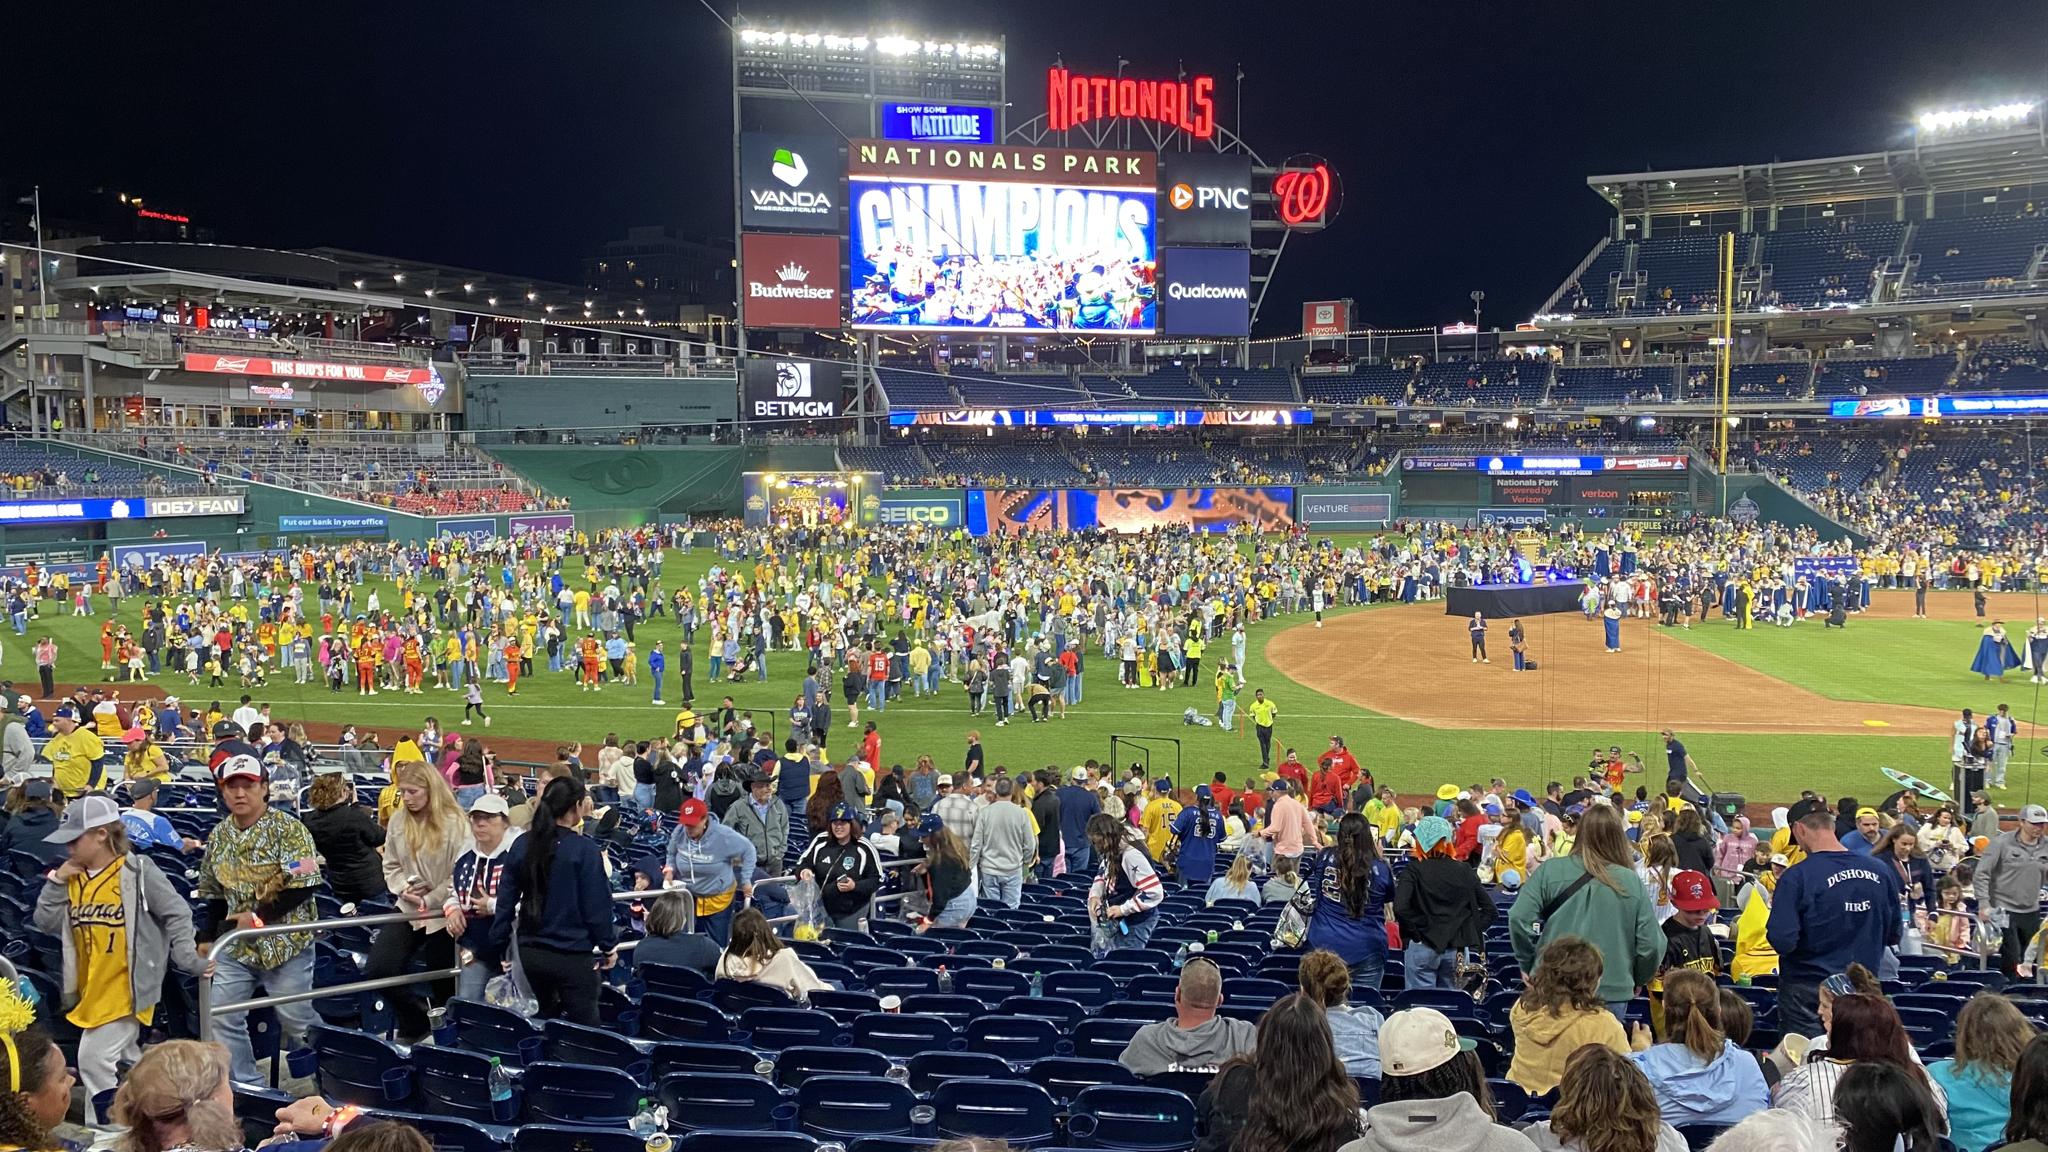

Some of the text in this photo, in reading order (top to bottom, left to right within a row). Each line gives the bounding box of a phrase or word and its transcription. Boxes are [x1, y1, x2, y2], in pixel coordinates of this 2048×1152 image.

[896, 106, 948, 114] SHOW SOME
[1049, 68, 1214, 137] NATIONALS
[911, 114, 981, 136] NATITUDE
[860, 145, 1142, 175] NATIONALS PARK
[750, 189, 832, 208] VANDA
[1196, 187, 1249, 210] PNC
[1275, 164, 1331, 225] W
[858, 183, 1149, 258] CHAMPIONS
[749, 281, 835, 300] Budweiser
[1168, 282, 1248, 300] Qualcomm
[210, 318, 239, 329] LOFT
[1311, 326, 1339, 335] TOYOTA
[270, 360, 366, 379] THIS BUD'S FOR YOU.
[755, 400, 834, 417] BETMGM
[1503, 487, 1553, 496] powered by
[1511, 495, 1544, 503] Verizon
[1581, 488, 1619, 498] verizon
[198, 499, 239, 514] FAN
[1306, 504, 1350, 513] VENTURE
[283, 518, 298, 526] Put
[312, 518, 333, 526] bank
[333, 518, 341, 526] in
[341, 519, 361, 527] your
[361, 518, 384, 526] office
[1495, 516, 1544, 525] DABOS
[276, 536, 288, 548] 377
[874, 660, 885, 671] 19
[1826, 868, 1881, 889] DUSHORE
[105, 931, 116, 954] 1
